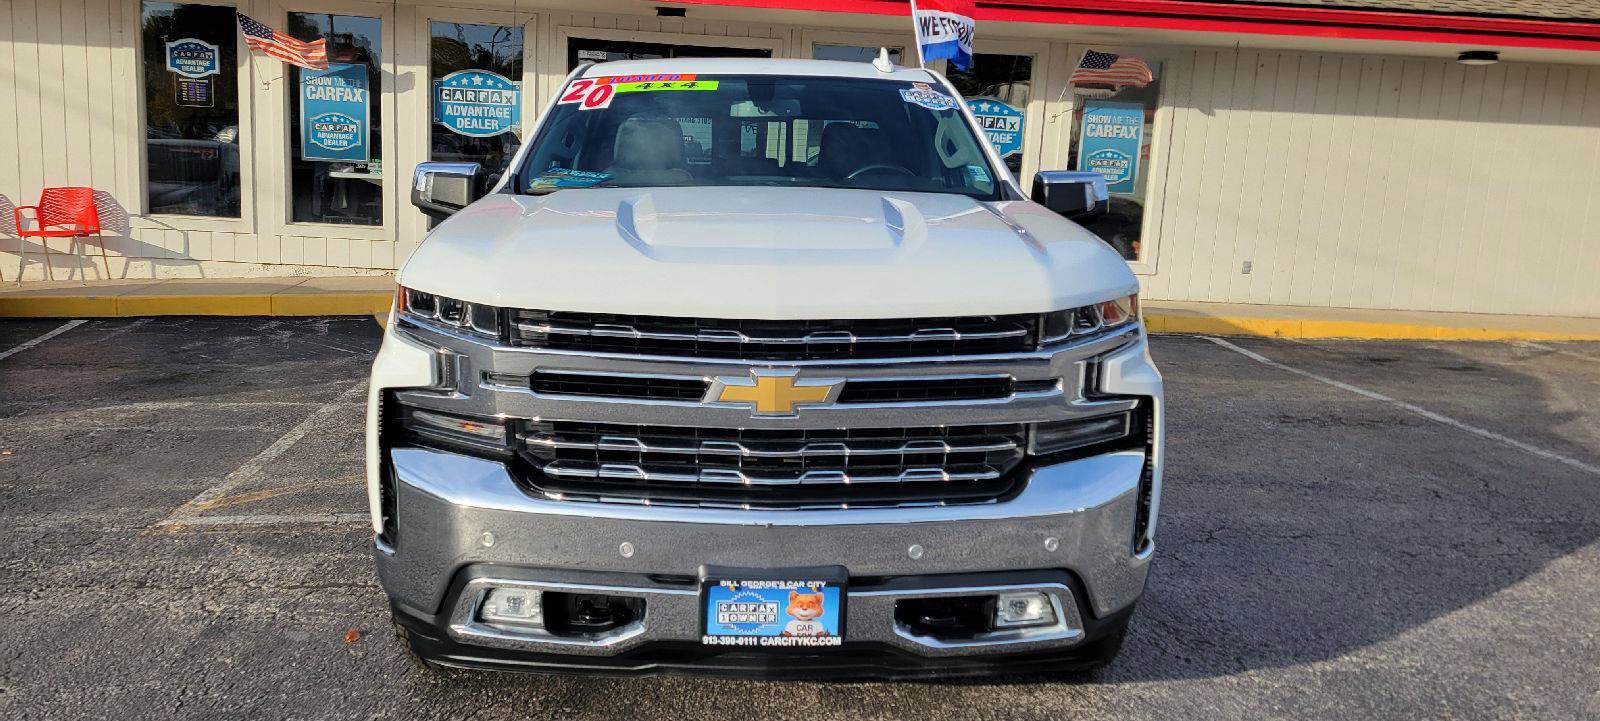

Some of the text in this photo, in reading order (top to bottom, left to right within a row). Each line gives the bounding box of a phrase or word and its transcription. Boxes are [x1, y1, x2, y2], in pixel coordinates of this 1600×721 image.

[920, 16, 940, 37] WE
[173, 50, 213, 59] CARFAX
[175, 59, 211, 67] ADVANTAGE
[305, 75, 363, 88] SHOW ME THE
[609, 74, 681, 84] LOADED
[306, 85, 363, 103] CARFAX
[440, 88, 513, 105] CARFAX
[561, 80, 613, 108] 20
[445, 105, 511, 118] ADVANTAGE
[456, 118, 499, 130] DEALER
[1087, 114, 1139, 126] SHOW ME THE
[315, 123, 357, 133] CARFAX
[1086, 124, 1138, 139] CARFAX
[317, 132, 353, 140] ADVANTAGE
[323, 139, 348, 147] DEALER
[1090, 160, 1128, 168] CARFAX
[720, 580, 827, 588] BILL GEORGE'S CAR CITY
[720, 602, 776, 613] CARFAX
[729, 614, 777, 623] OWNER
[796, 624, 813, 632] CAR
[761, 636, 842, 647] CARCITYKC.COM
